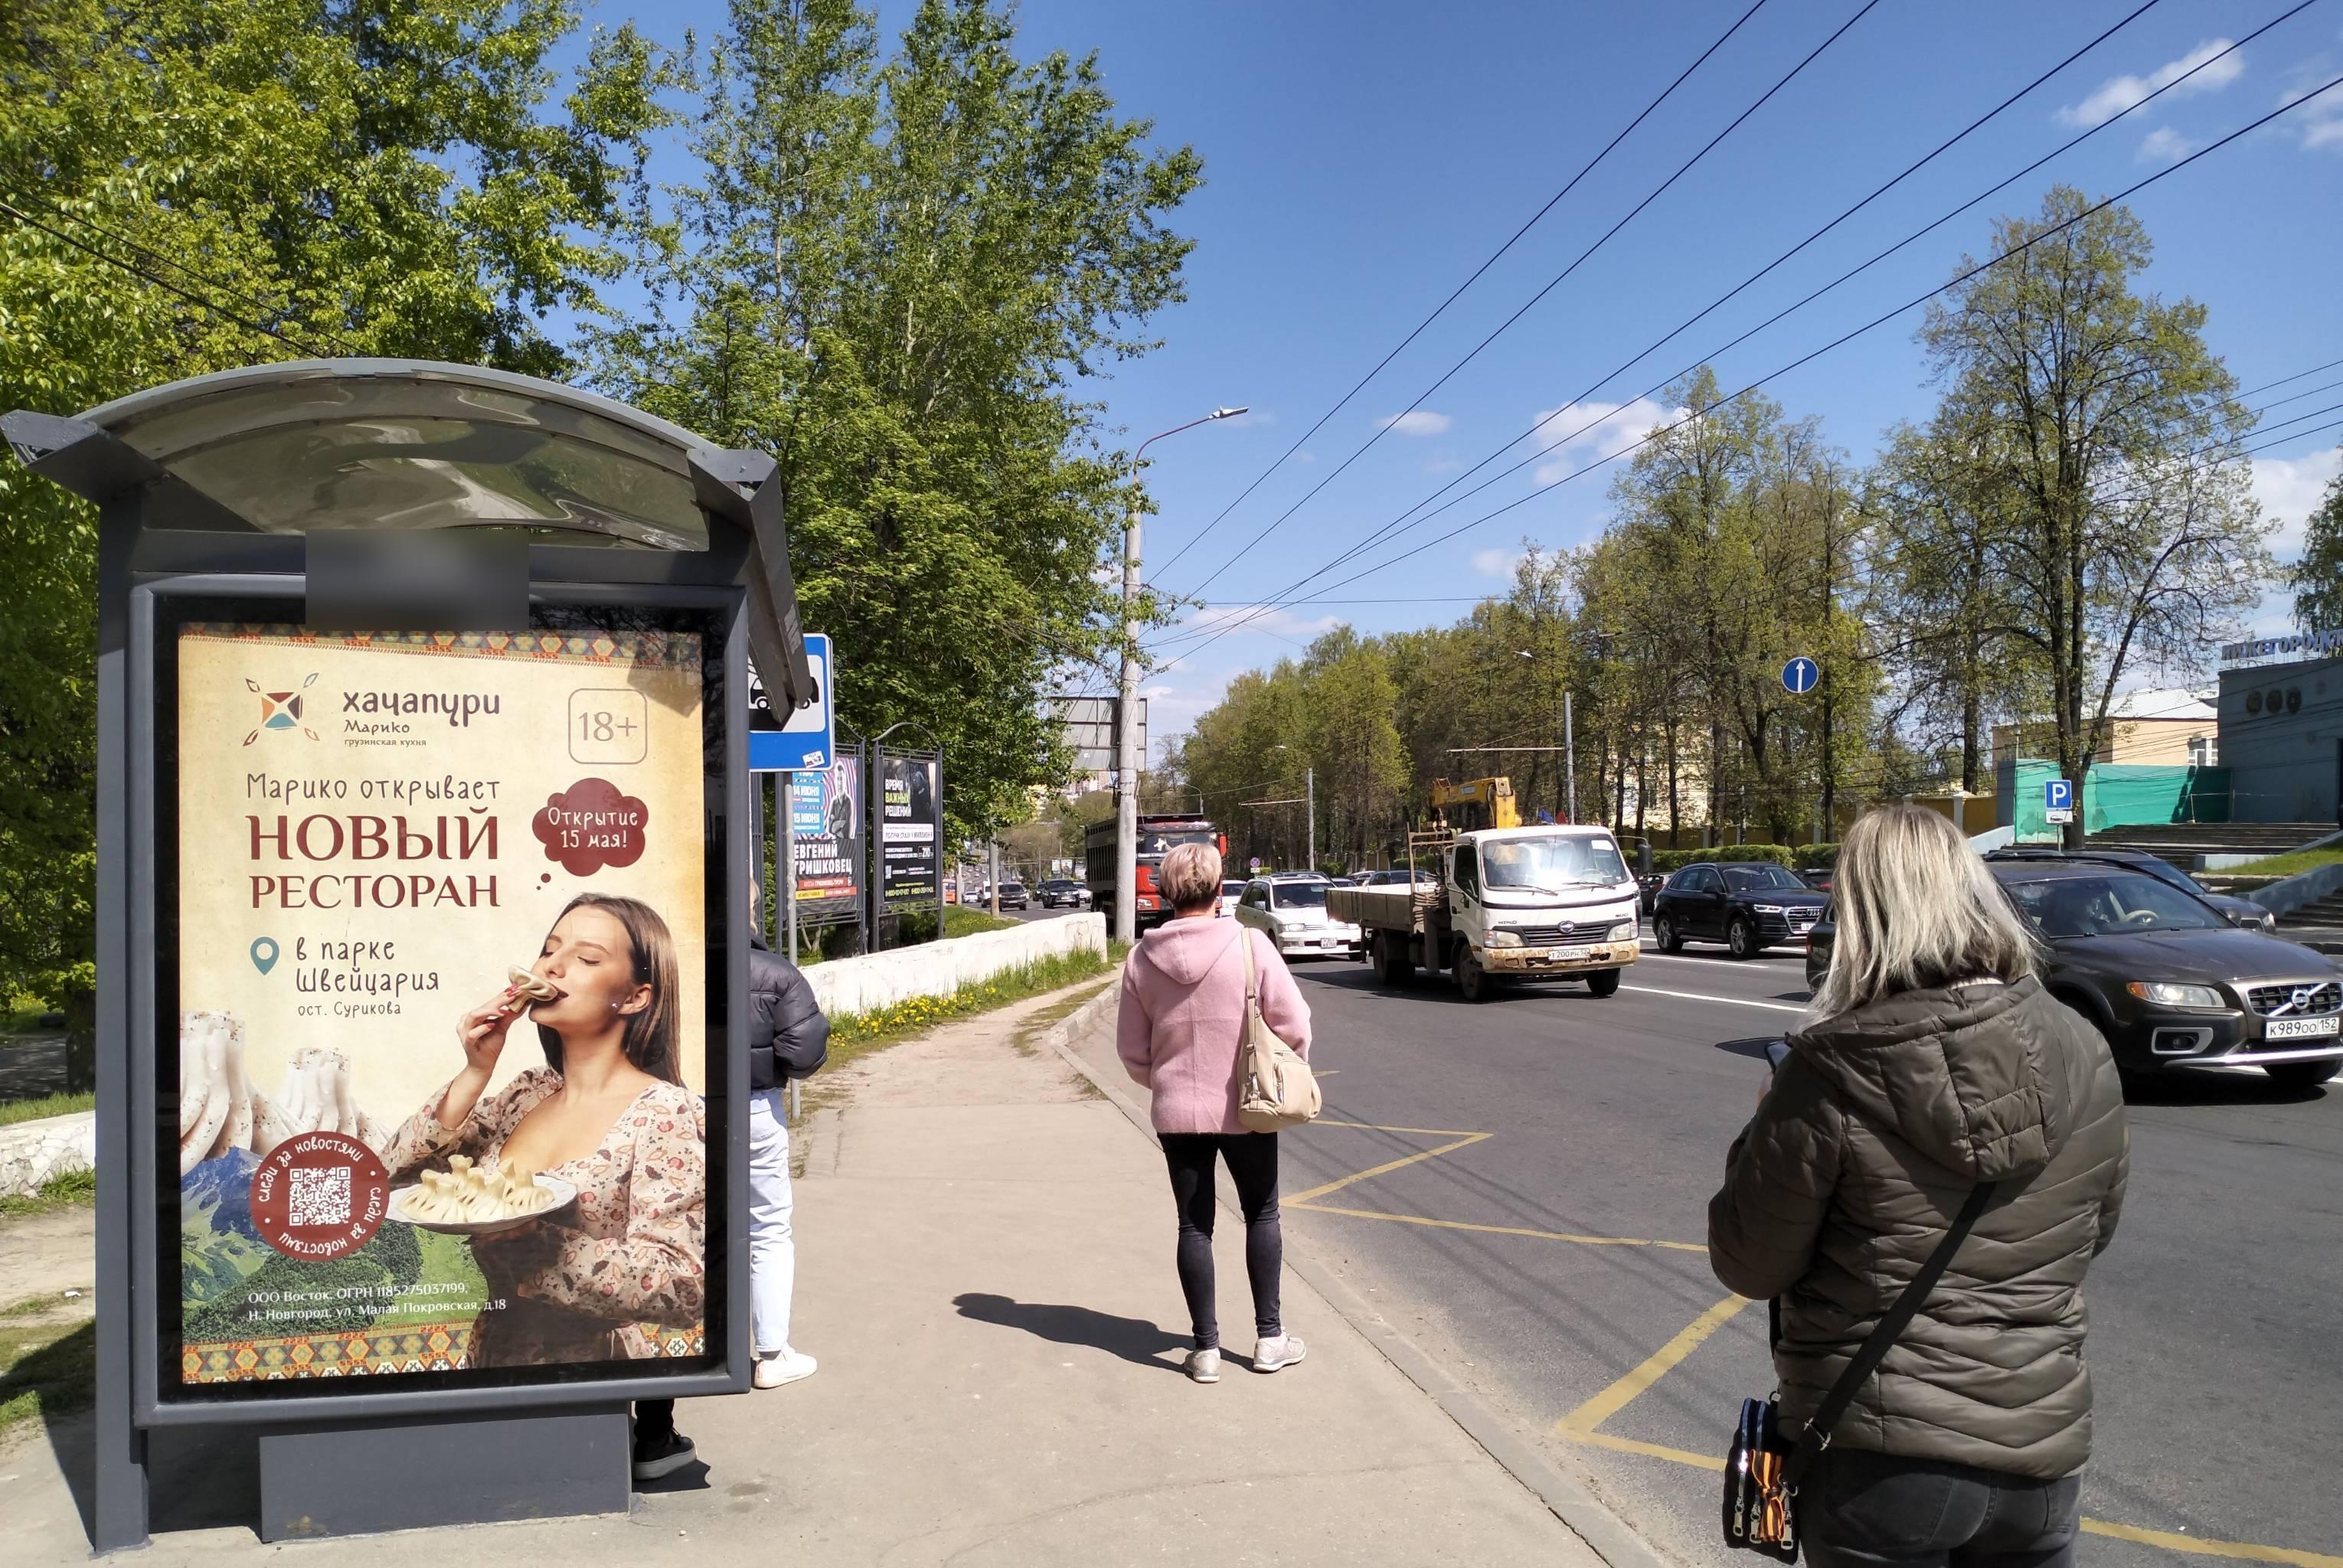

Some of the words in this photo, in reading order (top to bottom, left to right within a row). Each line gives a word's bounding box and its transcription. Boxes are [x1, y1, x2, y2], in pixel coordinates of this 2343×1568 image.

[341, 689, 501, 728] хачапури
[344, 720, 410, 737] Марико
[577, 711, 638, 743] 18+
[344, 738, 397, 748] грузинская
[400, 738, 427, 748] кухня
[247, 773, 348, 805] Марико
[360, 774, 501, 805] открывает
[885, 779, 904, 790] ВРЕМЯ
[885, 792, 910, 804] ВАЖНЫХ
[547, 807, 639, 830] Открытие
[885, 805, 912, 817] РЕШЕНИЙ
[245, 806, 498, 861] НОВЫЙ
[560, 830, 580, 849] 15
[587, 829, 629, 849] мая!
[794, 841, 838, 858] ЕВГЕНИЙ
[795, 859, 852, 874] ГРИШКОВЕЦ
[249, 874, 501, 910] РЕСТОРАН
[296, 937, 307, 961] в
[322, 940, 395, 970] парке
[296, 966, 440, 997] Швейцария
[297, 1003, 328, 1017] ост.
[333, 1001, 401, 1020] Сурикова
[259, 1166, 279, 1202] следи
[276, 1150, 292, 1168] за
[294, 1136, 364, 1163] новостями
[363, 1187, 381, 1223] следи
[350, 1223, 366, 1240] за
[278, 1232, 348, 1256] новостями
[248, 1292, 280, 1304] ООО
[336, 1287, 373, 1299] ОГРН
[249, 1310, 262, 1321] Н.
[266, 1308, 332, 1321] Новгород,
[358, 1303, 399, 1315] Малая
[404, 1302, 480, 1315] Покровская,
[483, 1298, 507, 1312] д.18
